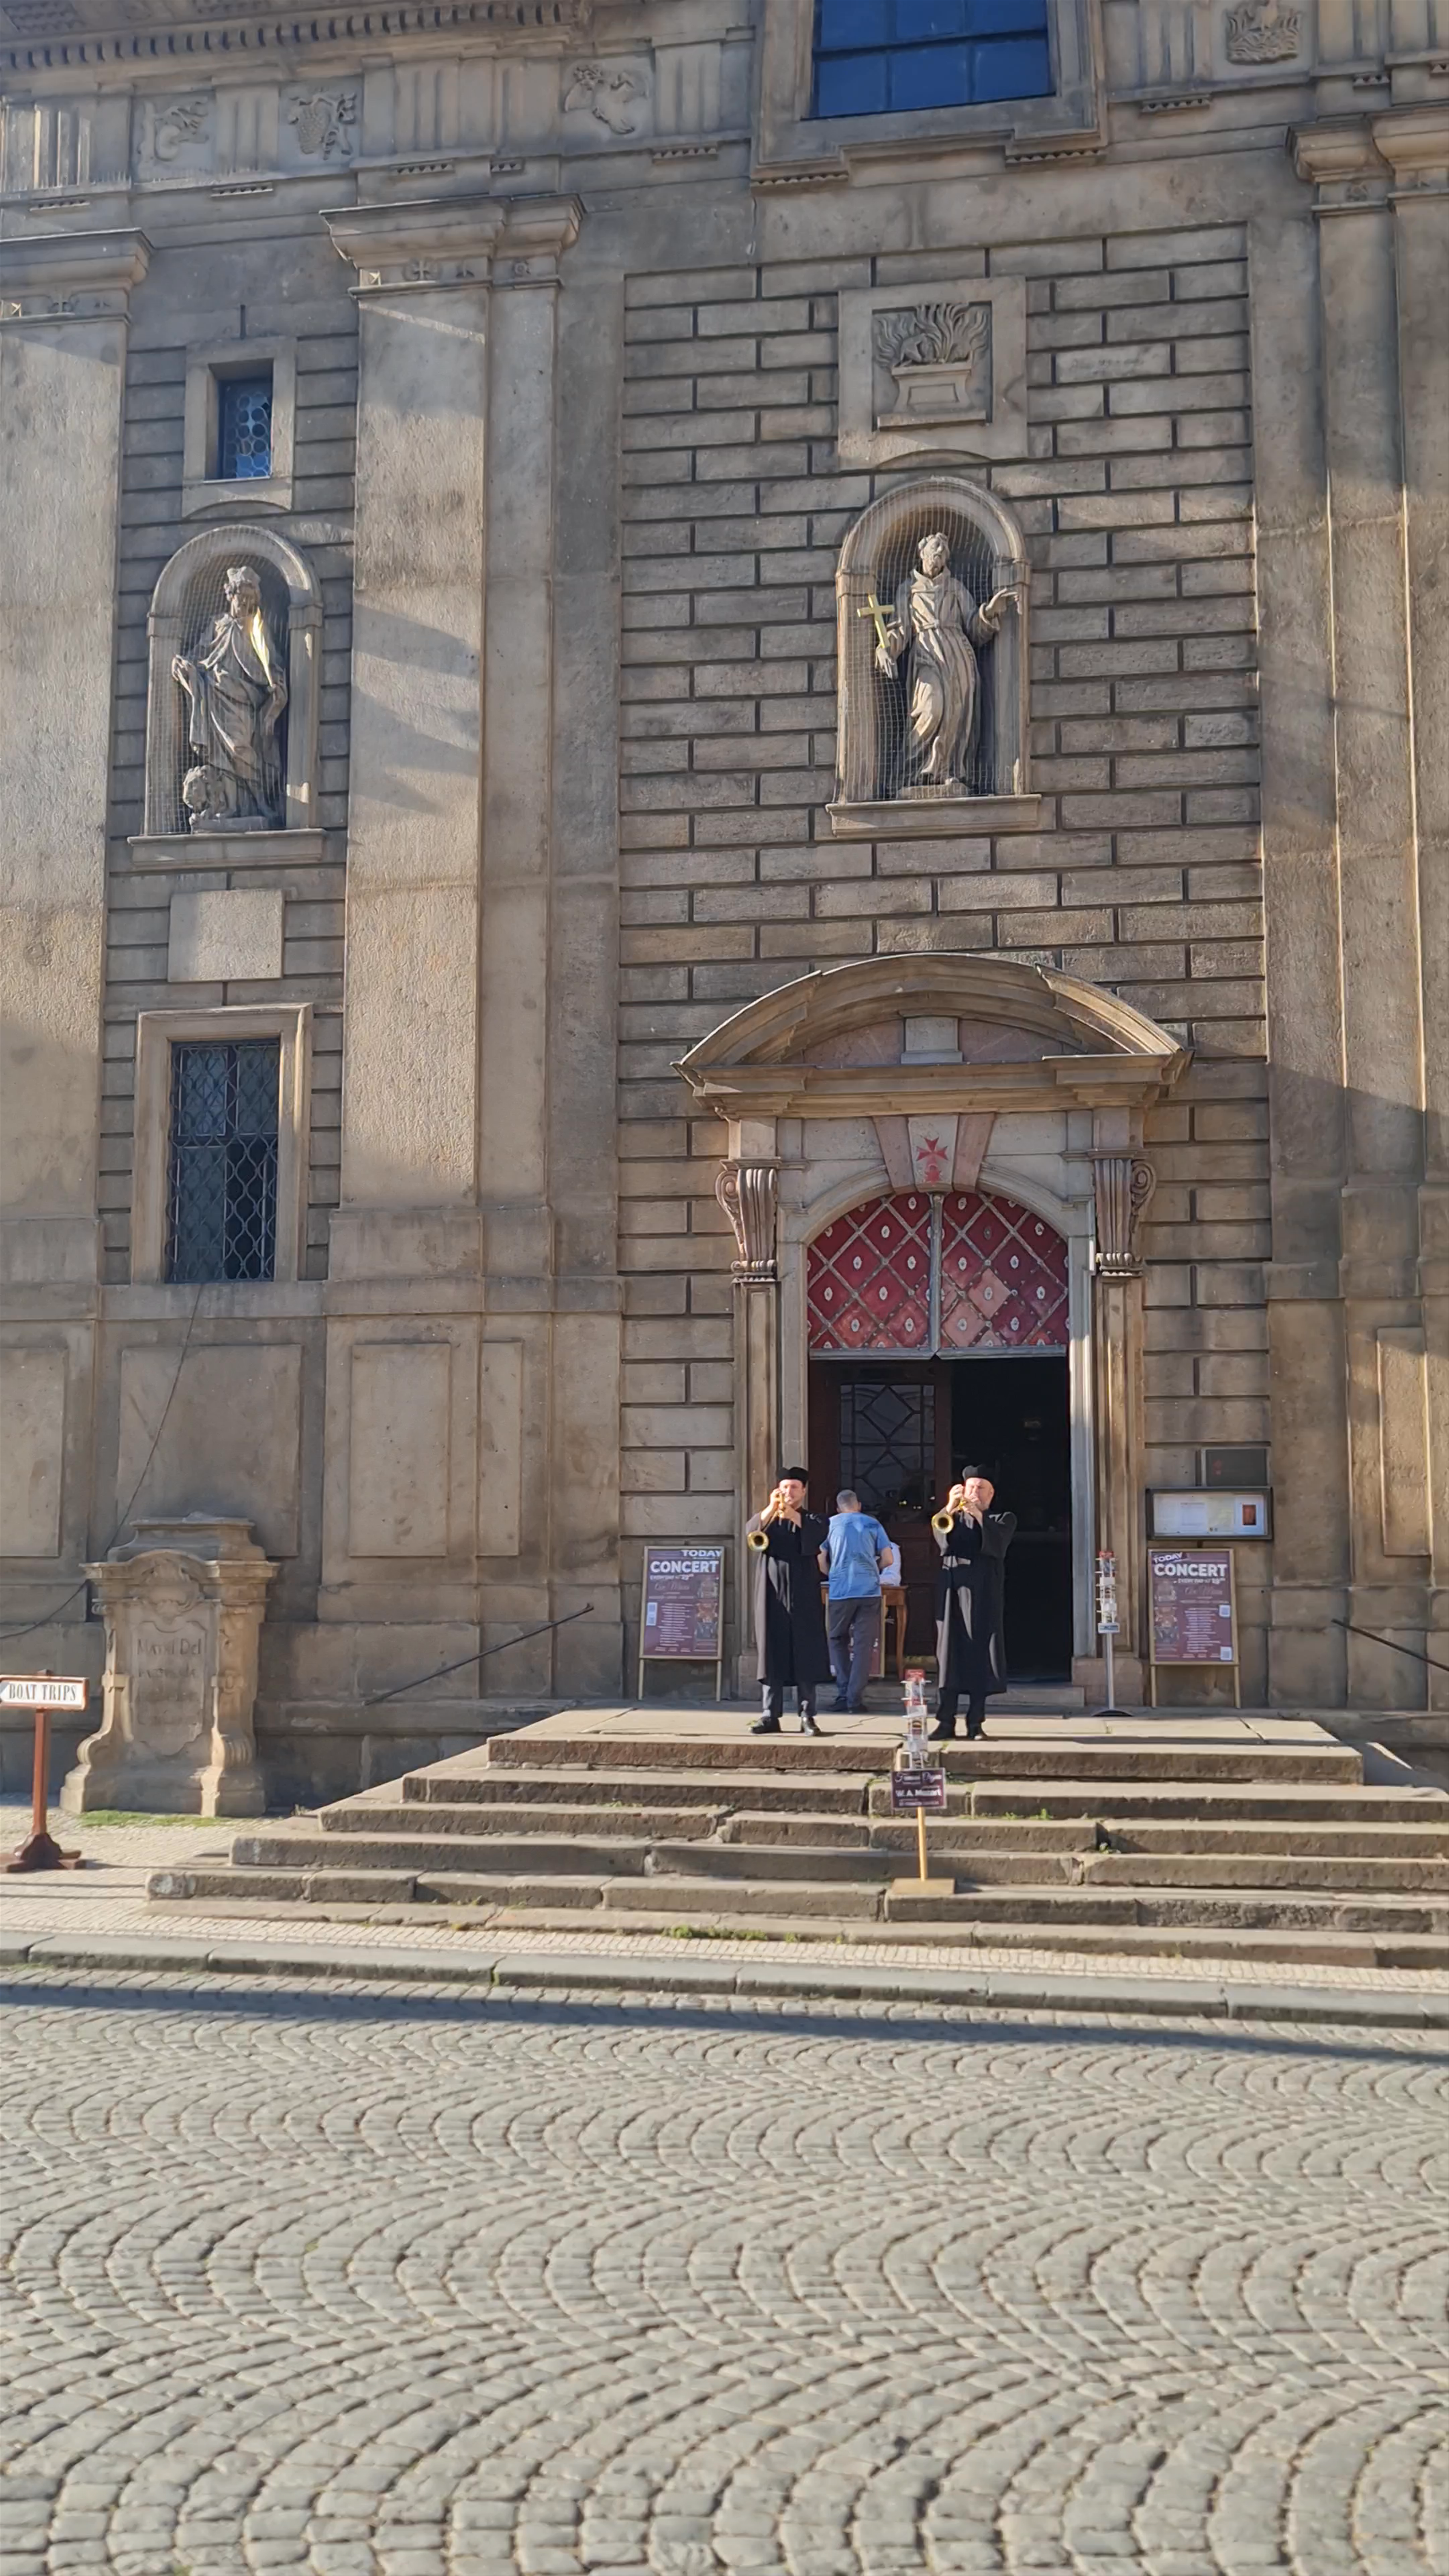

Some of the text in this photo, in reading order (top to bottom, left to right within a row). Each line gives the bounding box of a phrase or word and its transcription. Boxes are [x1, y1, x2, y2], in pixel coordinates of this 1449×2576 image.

[1153, 1552, 1183, 1563] TODAY
[650, 1560, 719, 1573] CONCERT
[1154, 1563, 1227, 1577] CONCERT
[9, 1683, 77, 1701] BOAT TRIPS
